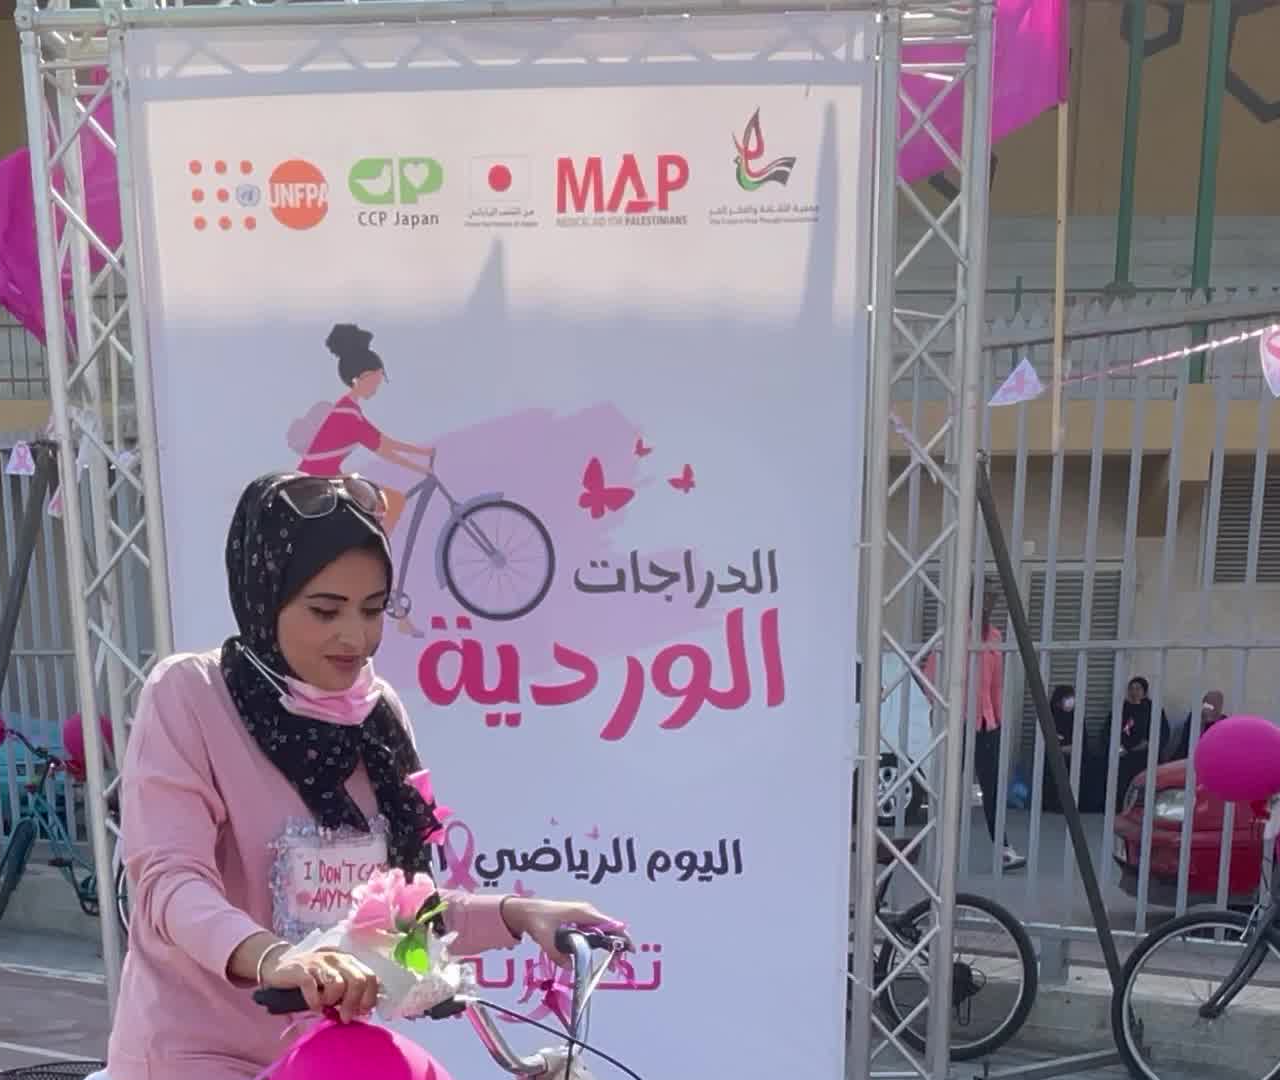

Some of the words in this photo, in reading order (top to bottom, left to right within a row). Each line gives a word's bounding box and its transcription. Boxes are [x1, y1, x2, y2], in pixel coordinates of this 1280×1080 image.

[267, 183, 330, 208] UNFPA
[555, 154, 690, 214] MAP
[358, 211, 387, 226] CCP
[393, 211, 439, 229] Japan
[573, 549, 779, 609] الدراجات
[417, 606, 786, 742] الوردية
[304, 861, 312, 880] I
[319, 859, 356, 884] DON'T
[474, 836, 637, 887] الرياضي
[645, 838, 743, 882] اليوم
